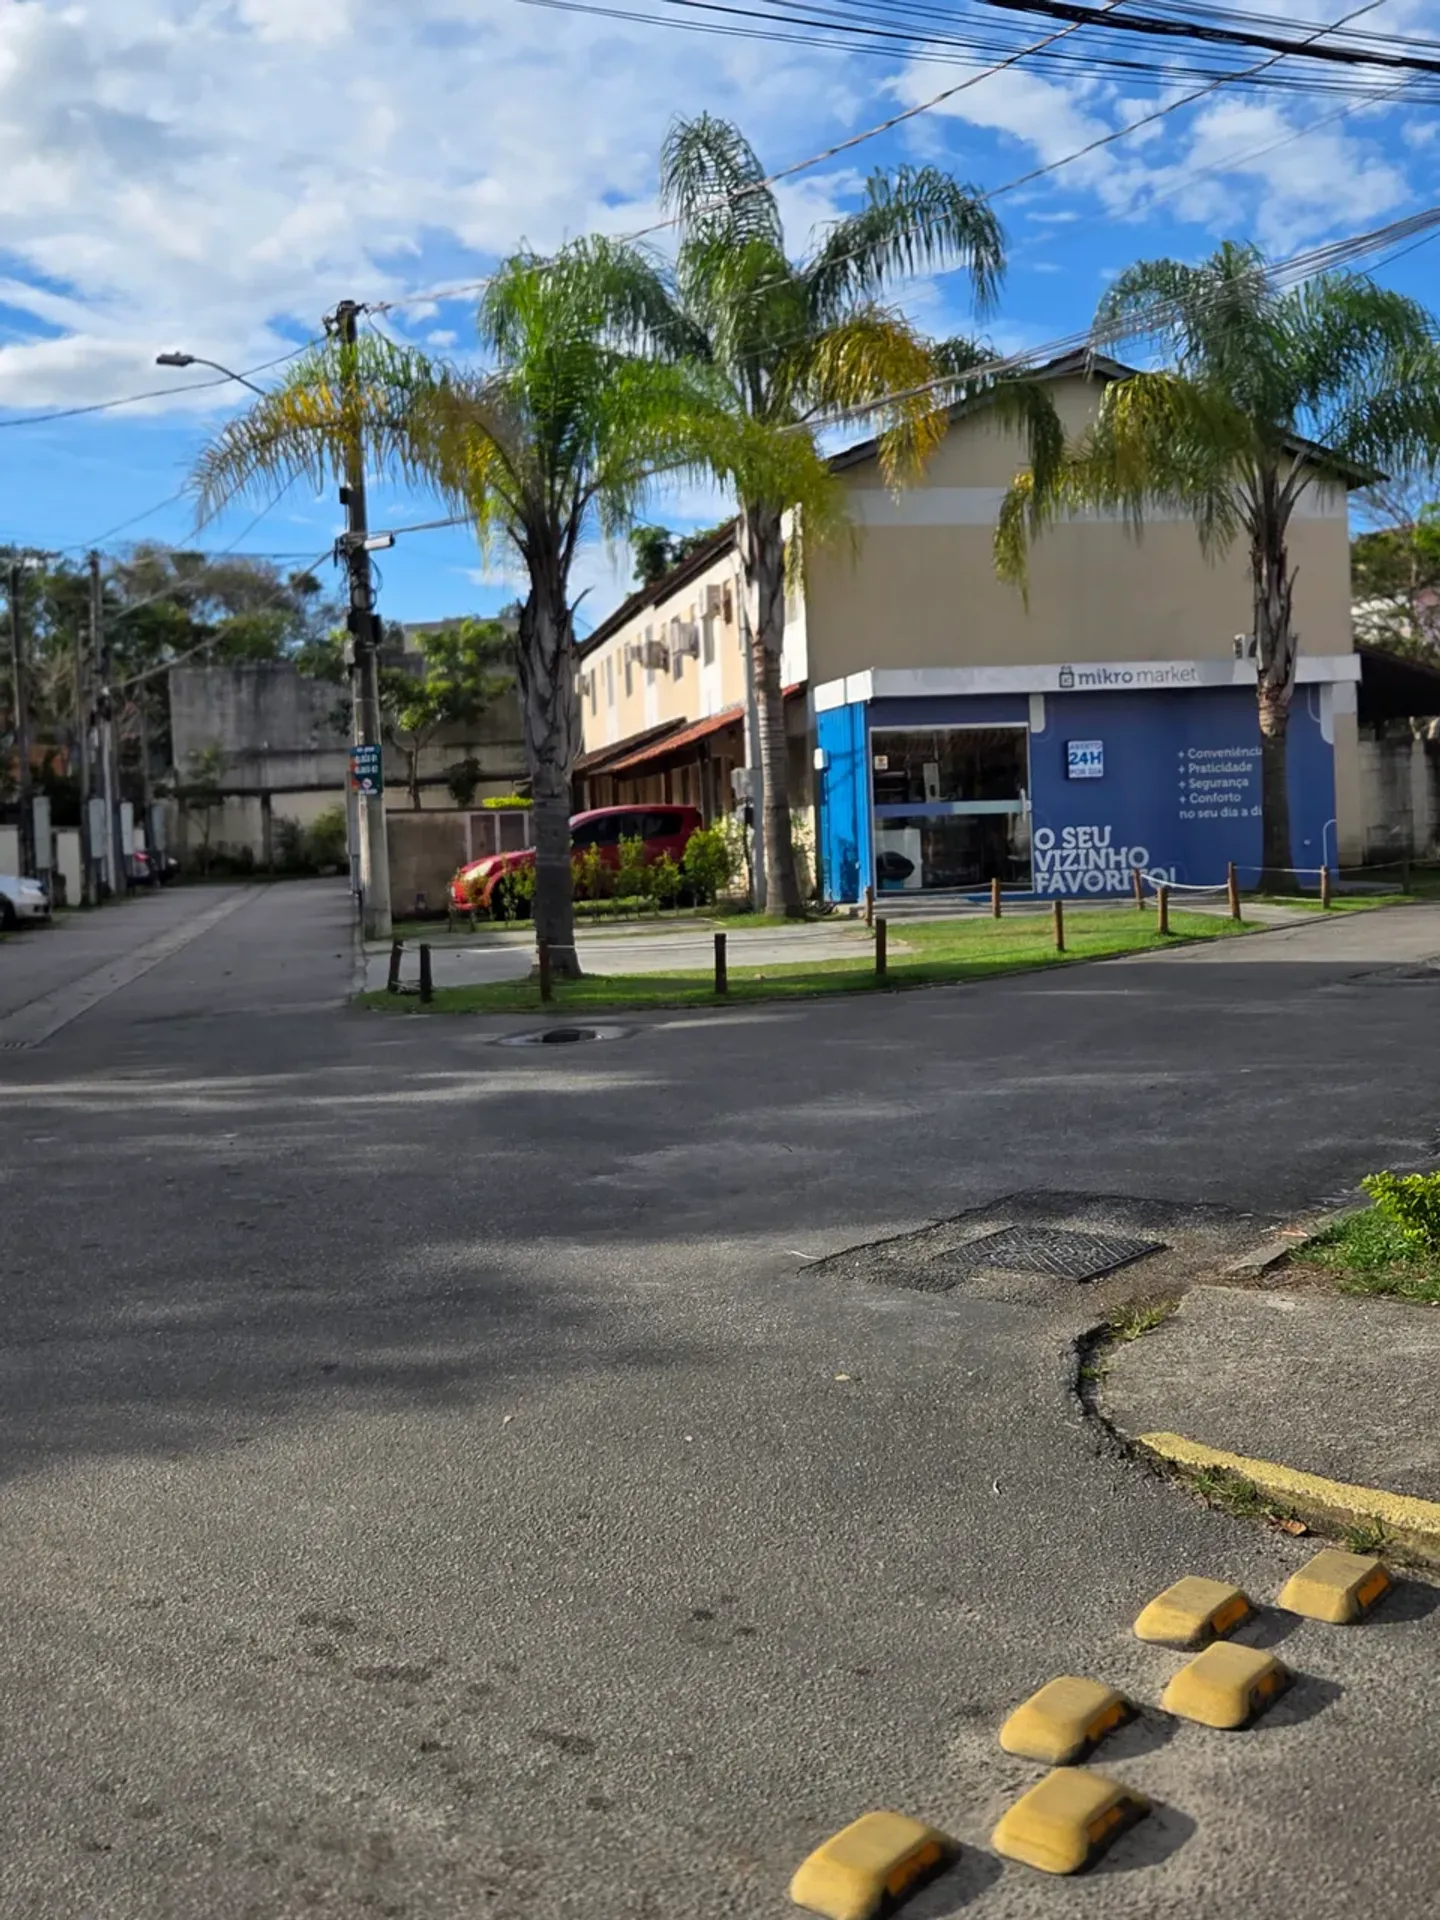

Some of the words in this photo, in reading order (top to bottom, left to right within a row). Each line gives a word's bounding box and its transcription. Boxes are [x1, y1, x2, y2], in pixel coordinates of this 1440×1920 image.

[1078, 667, 1134, 685] mikro
[1136, 665, 1197, 684] market
[1069, 751, 1102, 765] 24H
[1187, 746, 1263, 759] Conveniênci
[1188, 760, 1253, 774] Praticidade
[1188, 777, 1249, 791] Segurança
[1189, 791, 1242, 804] Conforto
[1179, 809, 1196, 819] no
[1198, 809, 1218, 818] seu
[1220, 805, 1239, 817] dia
[1241, 807, 1249, 817] a
[1250, 804, 1263, 816] di
[1034, 827, 1056, 850] O
[1061, 825, 1112, 849] SEU
[1034, 846, 1150, 871] VIZINHO
